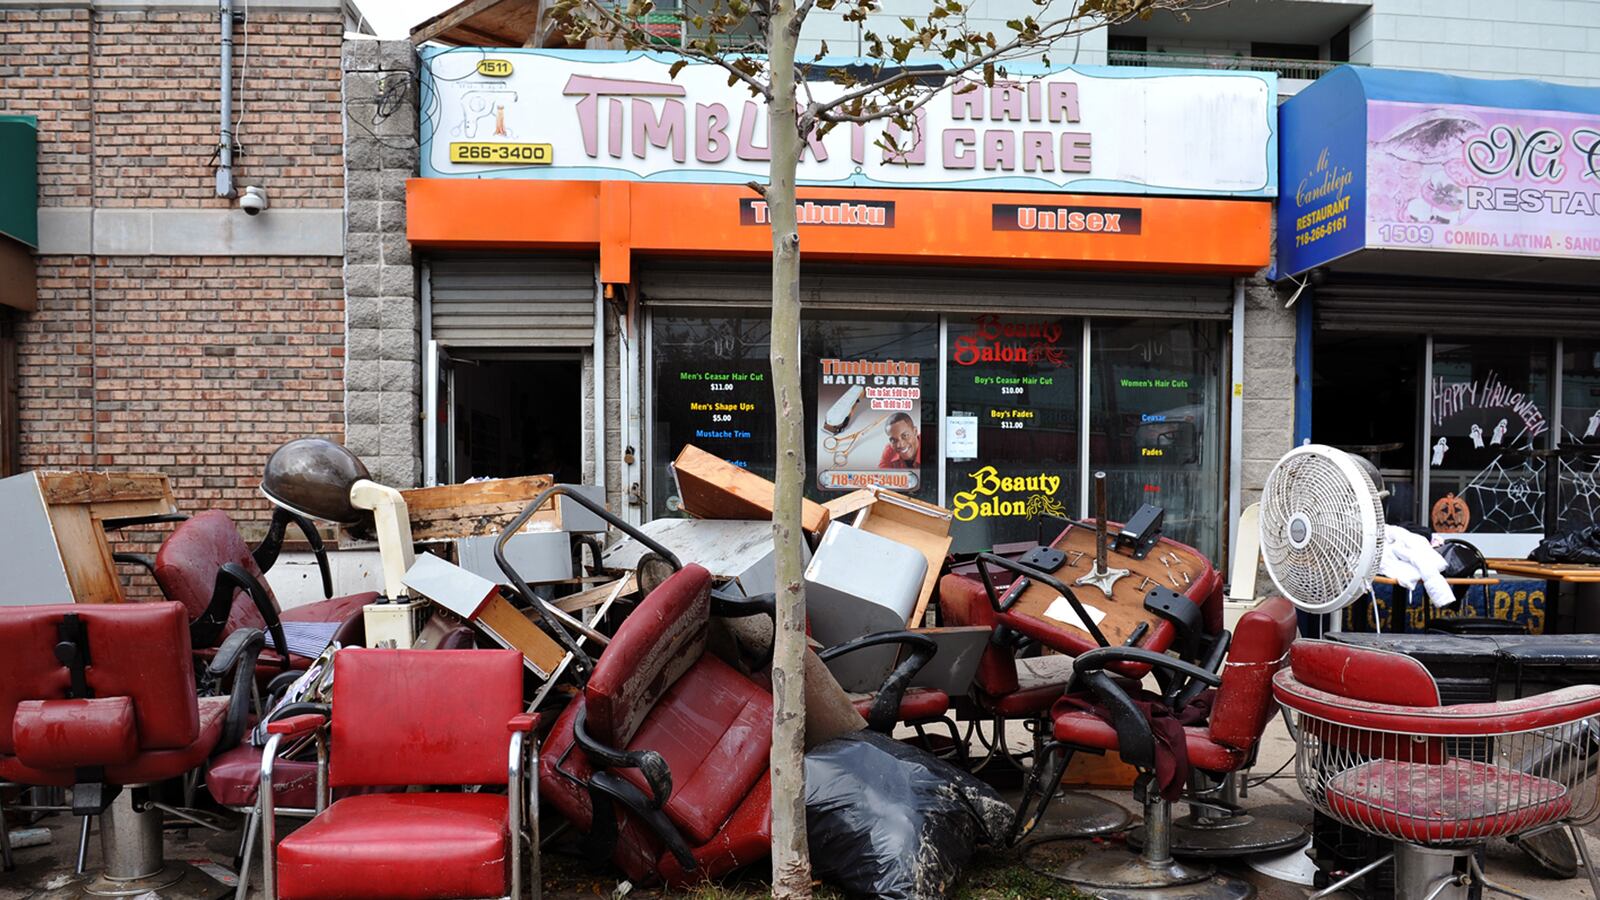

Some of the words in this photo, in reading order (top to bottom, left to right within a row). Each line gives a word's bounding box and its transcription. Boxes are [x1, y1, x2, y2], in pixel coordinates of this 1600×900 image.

[480, 61, 509, 73] 1511
[951, 79, 1081, 123] HAIR
[458, 146, 545, 160] 266-3400
[941, 128, 1092, 173] CARE
[750, 200, 886, 226] Tbuktu
[1017, 206, 1122, 232] Unisex
[1296, 195, 1351, 231] RESTAURANT
[1296, 215, 1347, 249] 718-266-6161
[1378, 224, 1434, 243] 1509
[1444, 230, 1500, 247] COMIDA
[1503, 233, 1553, 249] LATINA
[970, 313, 1063, 342] Beauty
[953, 335, 1028, 366] Salon
[820, 359, 920, 376] Timbuktu
[680, 372, 702, 380] Men's
[704, 372, 730, 381] Ceasar
[731, 372, 748, 381] Hair
[749, 372, 764, 381] Cut
[823, 375, 866, 385] HAIR
[873, 376, 920, 386] CARE
[974, 375, 994, 385] Boy's
[995, 376, 1020, 384] Ceasar
[1022, 376, 1038, 384] Hair
[1039, 377, 1053, 385] Cut
[1120, 379, 1153, 388] Women's
[1154, 379, 1170, 388] Hair
[1171, 380, 1189, 388] Cuts
[710, 383, 734, 391] $11.00
[690, 403, 713, 411] Men's
[714, 403, 738, 412] Shape
[739, 403, 755, 412] Ups
[1432, 376, 1478, 427] HAPPY
[712, 414, 732, 422] $5.00
[990, 410, 1011, 419] Boy's
[1012, 410, 1034, 418] Fades
[1141, 413, 1166, 422] Ceasar
[696, 430, 733, 439] Mustache
[734, 430, 751, 439] Trim
[1141, 448, 1163, 456] Fades
[968, 465, 1061, 495] Beauty
[953, 491, 1028, 521] Salon
